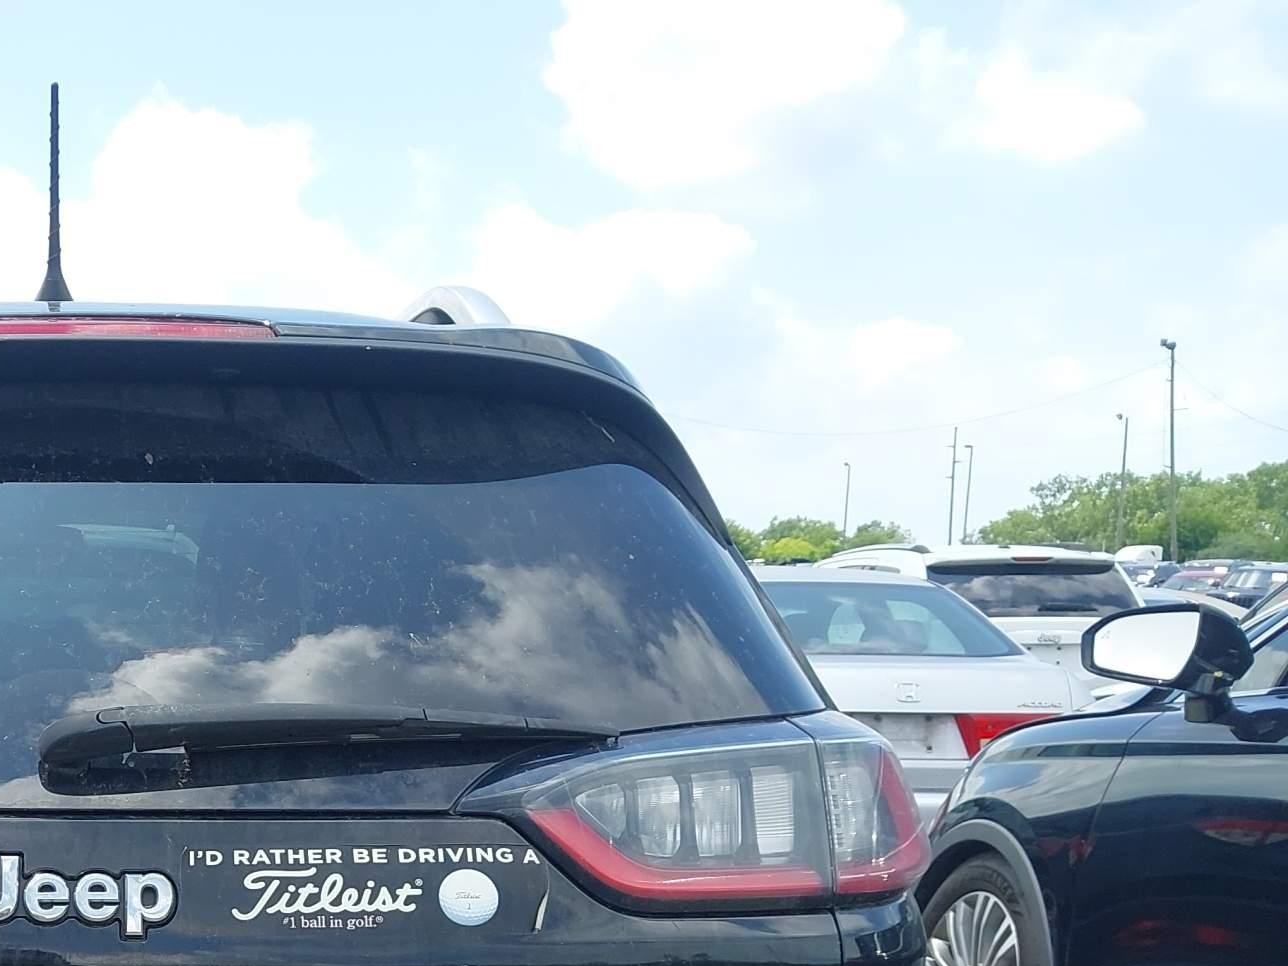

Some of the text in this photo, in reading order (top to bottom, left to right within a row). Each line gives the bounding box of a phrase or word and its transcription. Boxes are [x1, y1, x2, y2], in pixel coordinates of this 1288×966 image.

[189, 847, 541, 866] I'D RATHER BE DRIVING A
[300, 915, 326, 929] ball
[329, 915, 344, 928] in
